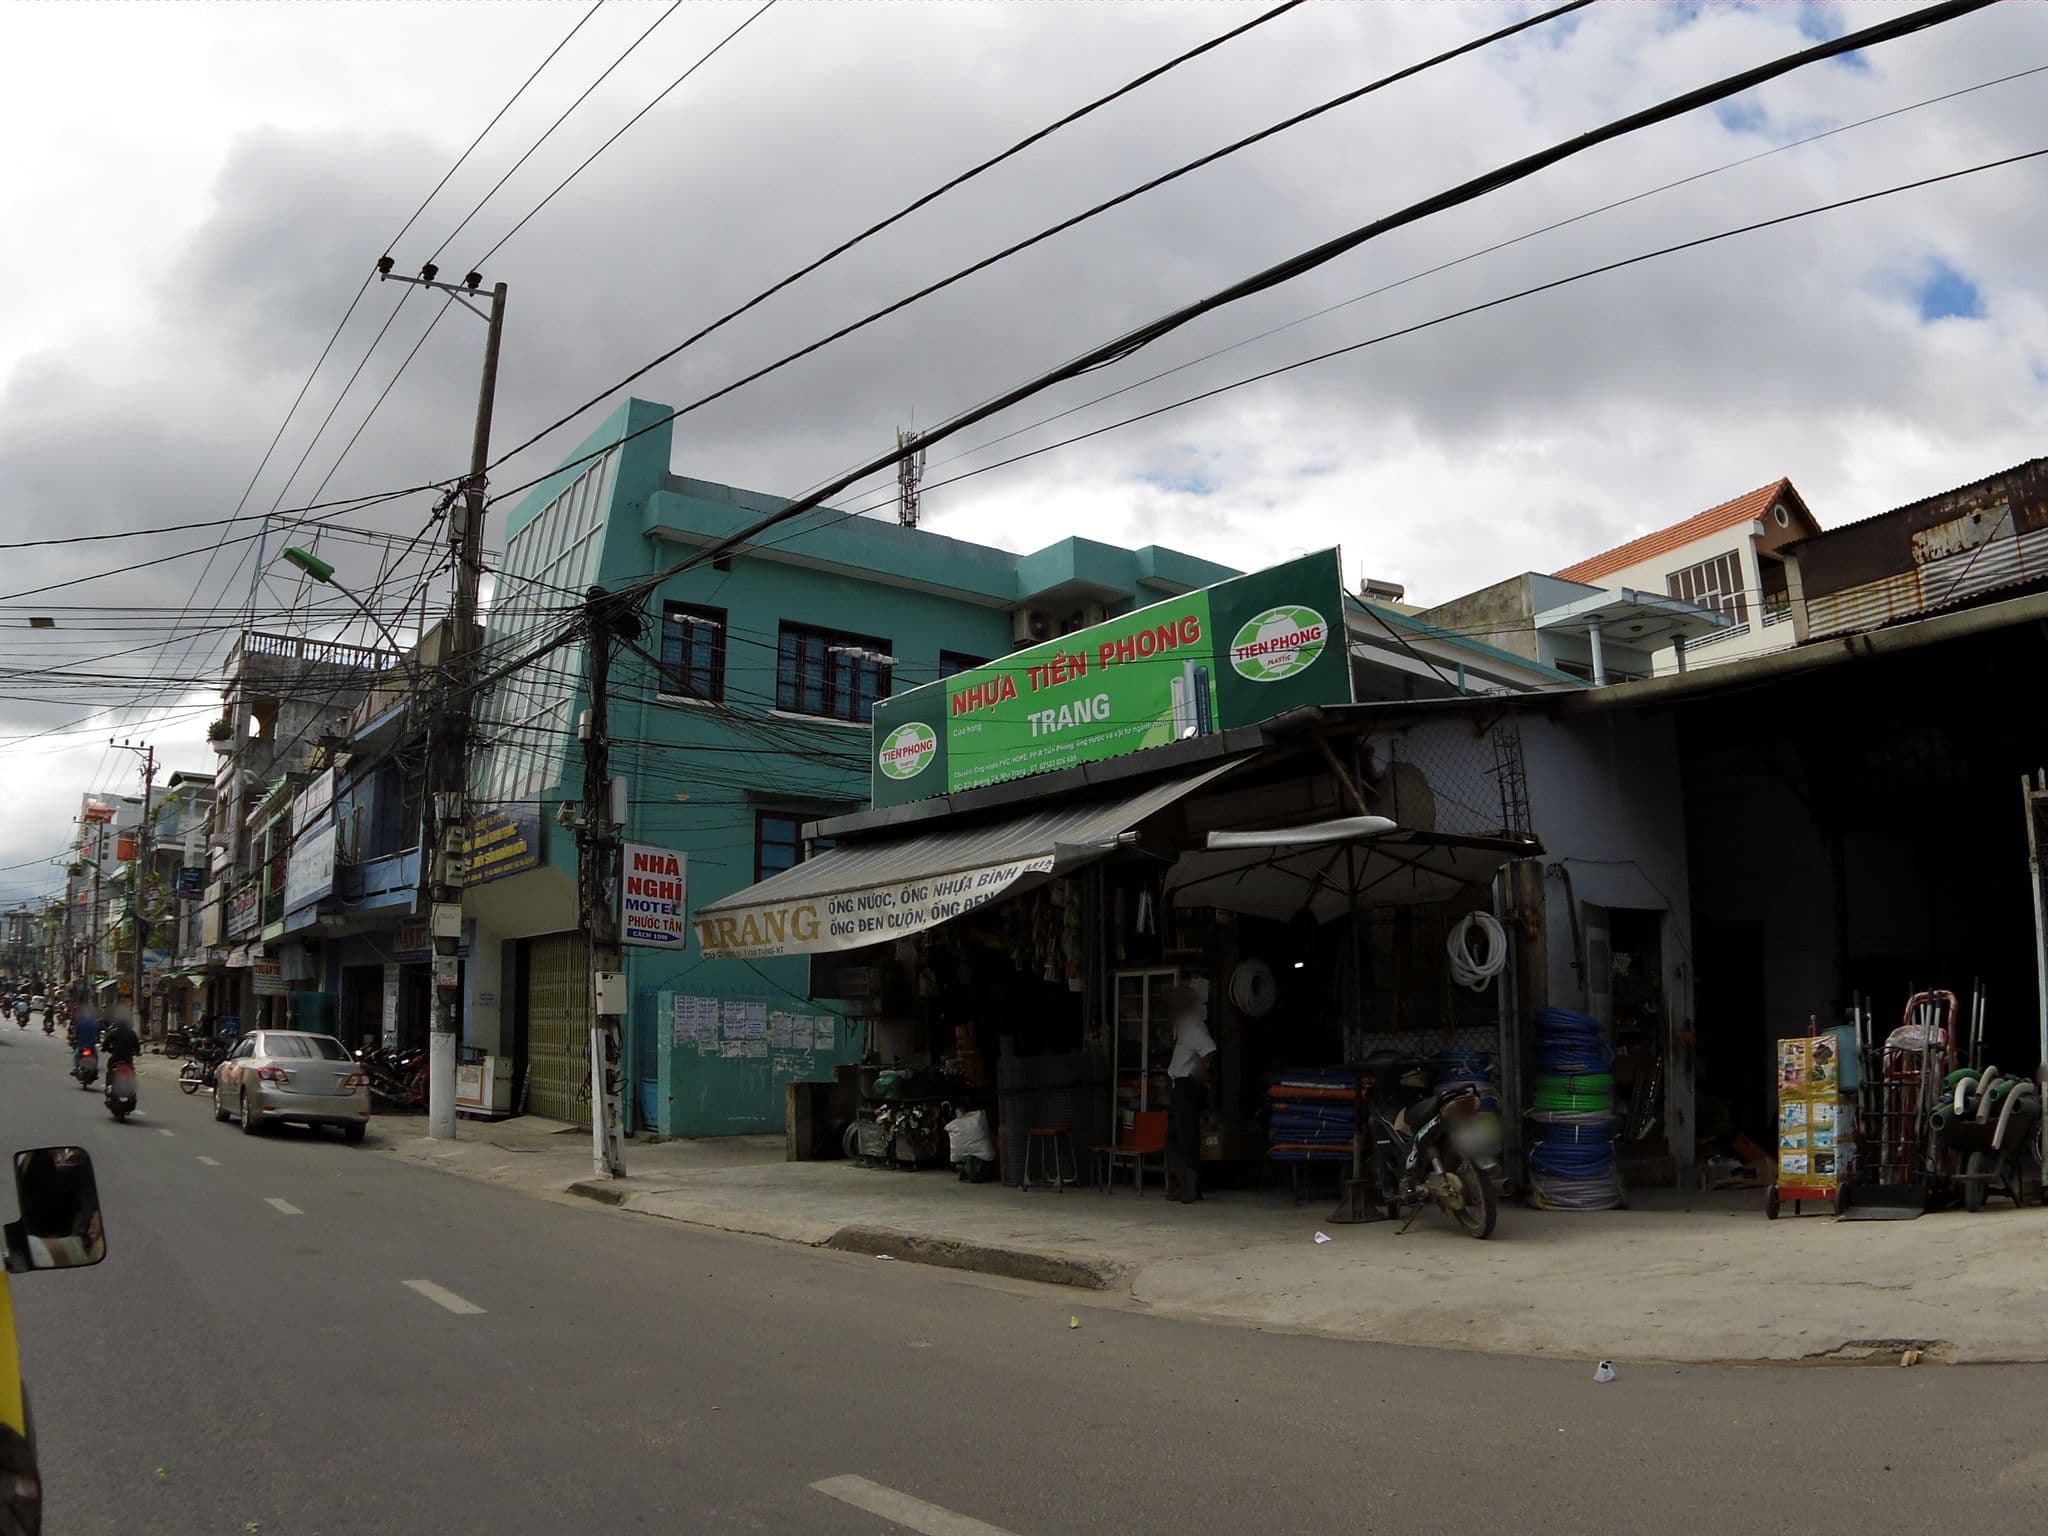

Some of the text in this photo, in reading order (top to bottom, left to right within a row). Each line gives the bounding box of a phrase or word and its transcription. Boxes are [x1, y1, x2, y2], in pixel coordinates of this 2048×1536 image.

[1270, 627, 1321, 653] PHONG
[952, 615, 1202, 718] NHỰA TIỀN PHONG
[1027, 692, 1110, 738] TRANG
[902, 740, 933, 758] PHONG
[634, 853, 680, 876] NHÀ
[627, 876, 683, 901] NGHỈ
[828, 896, 854, 915] ỐNG
[901, 884, 928, 904] ỐNG
[933, 876, 973, 897] NHỰA
[977, 866, 1018, 887] BÌNH
[625, 898, 681, 916] MOTEL
[830, 917, 854, 936] ỐNG
[858, 916, 884, 932] ĐEN
[888, 908, 927, 929] CUỘN,
[931, 900, 961, 920] ỐNG
[628, 914, 682, 932] PHƯỚC TÂN
